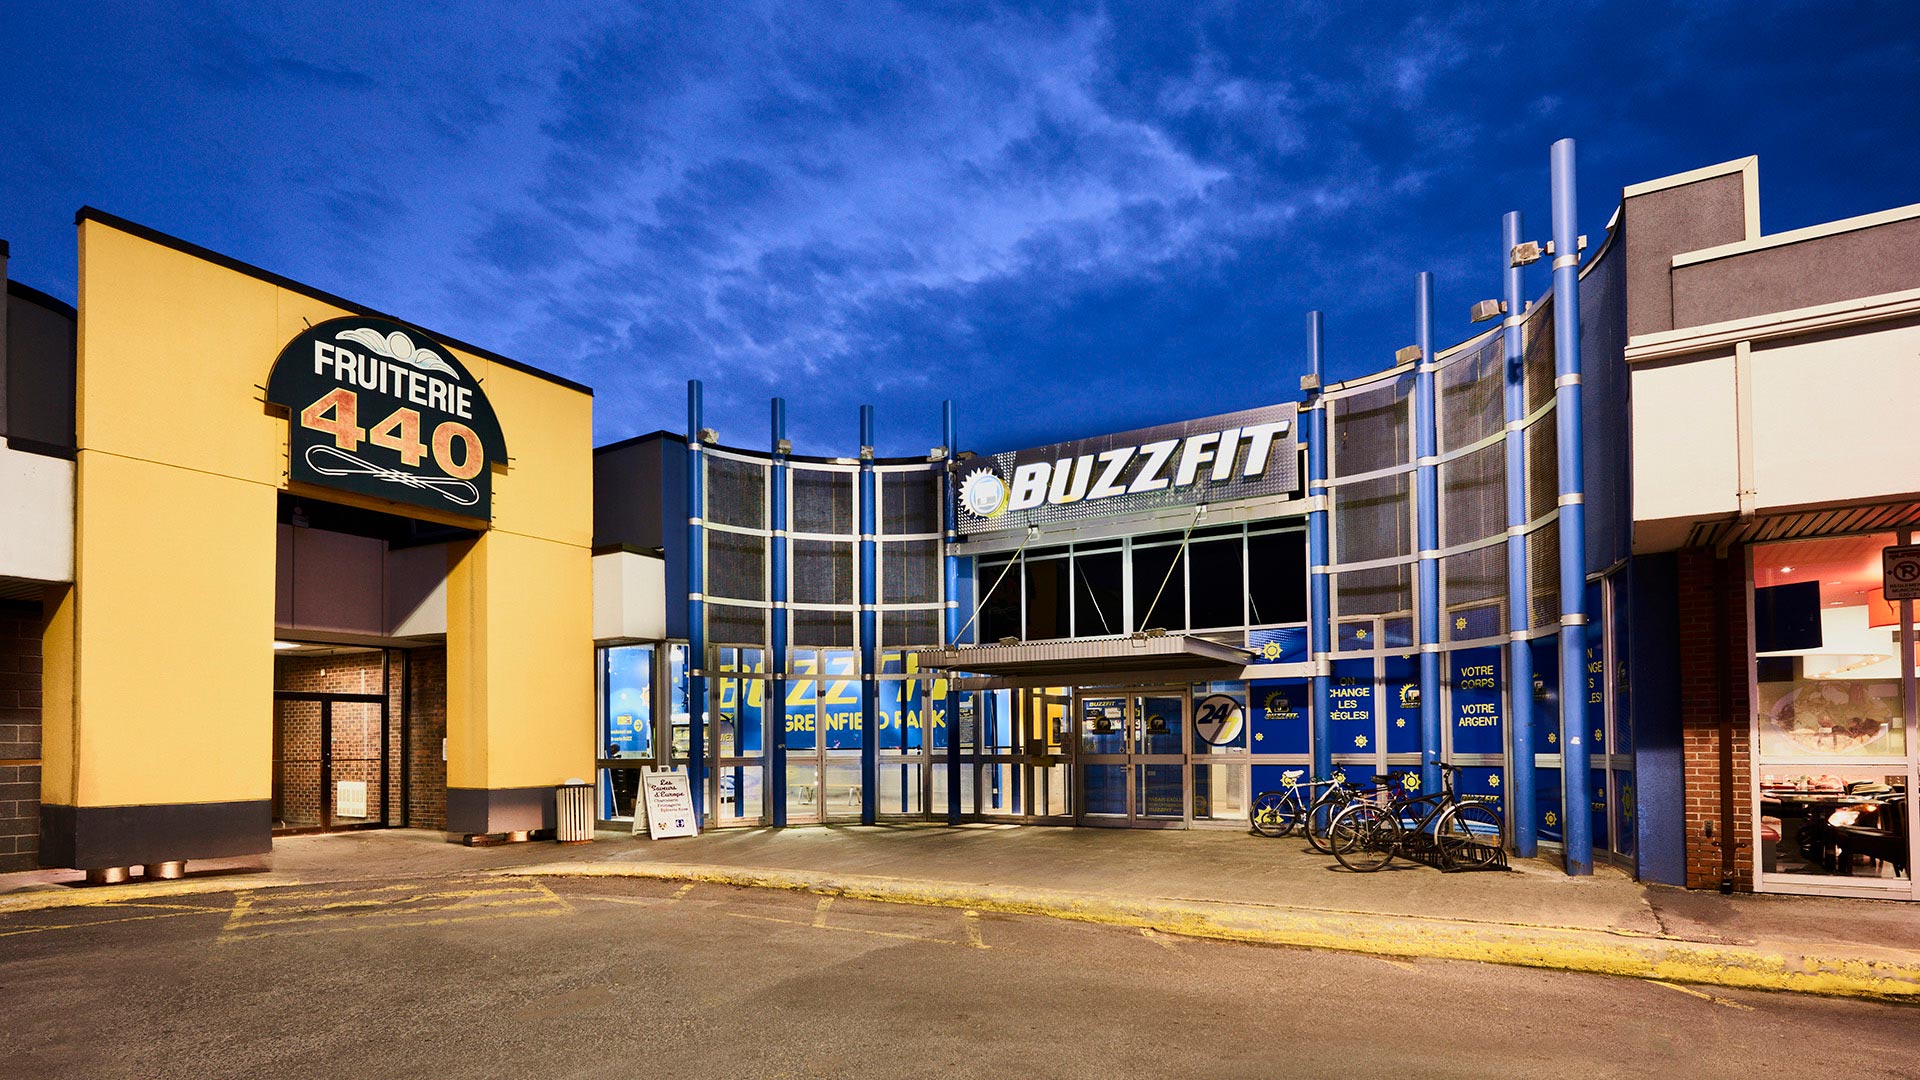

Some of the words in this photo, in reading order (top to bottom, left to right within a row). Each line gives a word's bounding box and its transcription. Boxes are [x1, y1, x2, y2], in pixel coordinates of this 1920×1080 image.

[314, 339, 473, 420] FRUITERIE
[301, 387, 484, 480] 440
[1008, 419, 1290, 512] BUZZFIT
[1461, 665, 1494, 677] VOTRE
[719, 652, 948, 708] BUZZI
[1340, 677, 1355, 687] ON
[1461, 678, 1495, 689] CORPS
[1338, 700, 1358, 709] LES
[1462, 703, 1495, 714] VOTRE
[785, 711, 890, 733] GRENFIED
[1459, 716, 1499, 727] ARGENT
